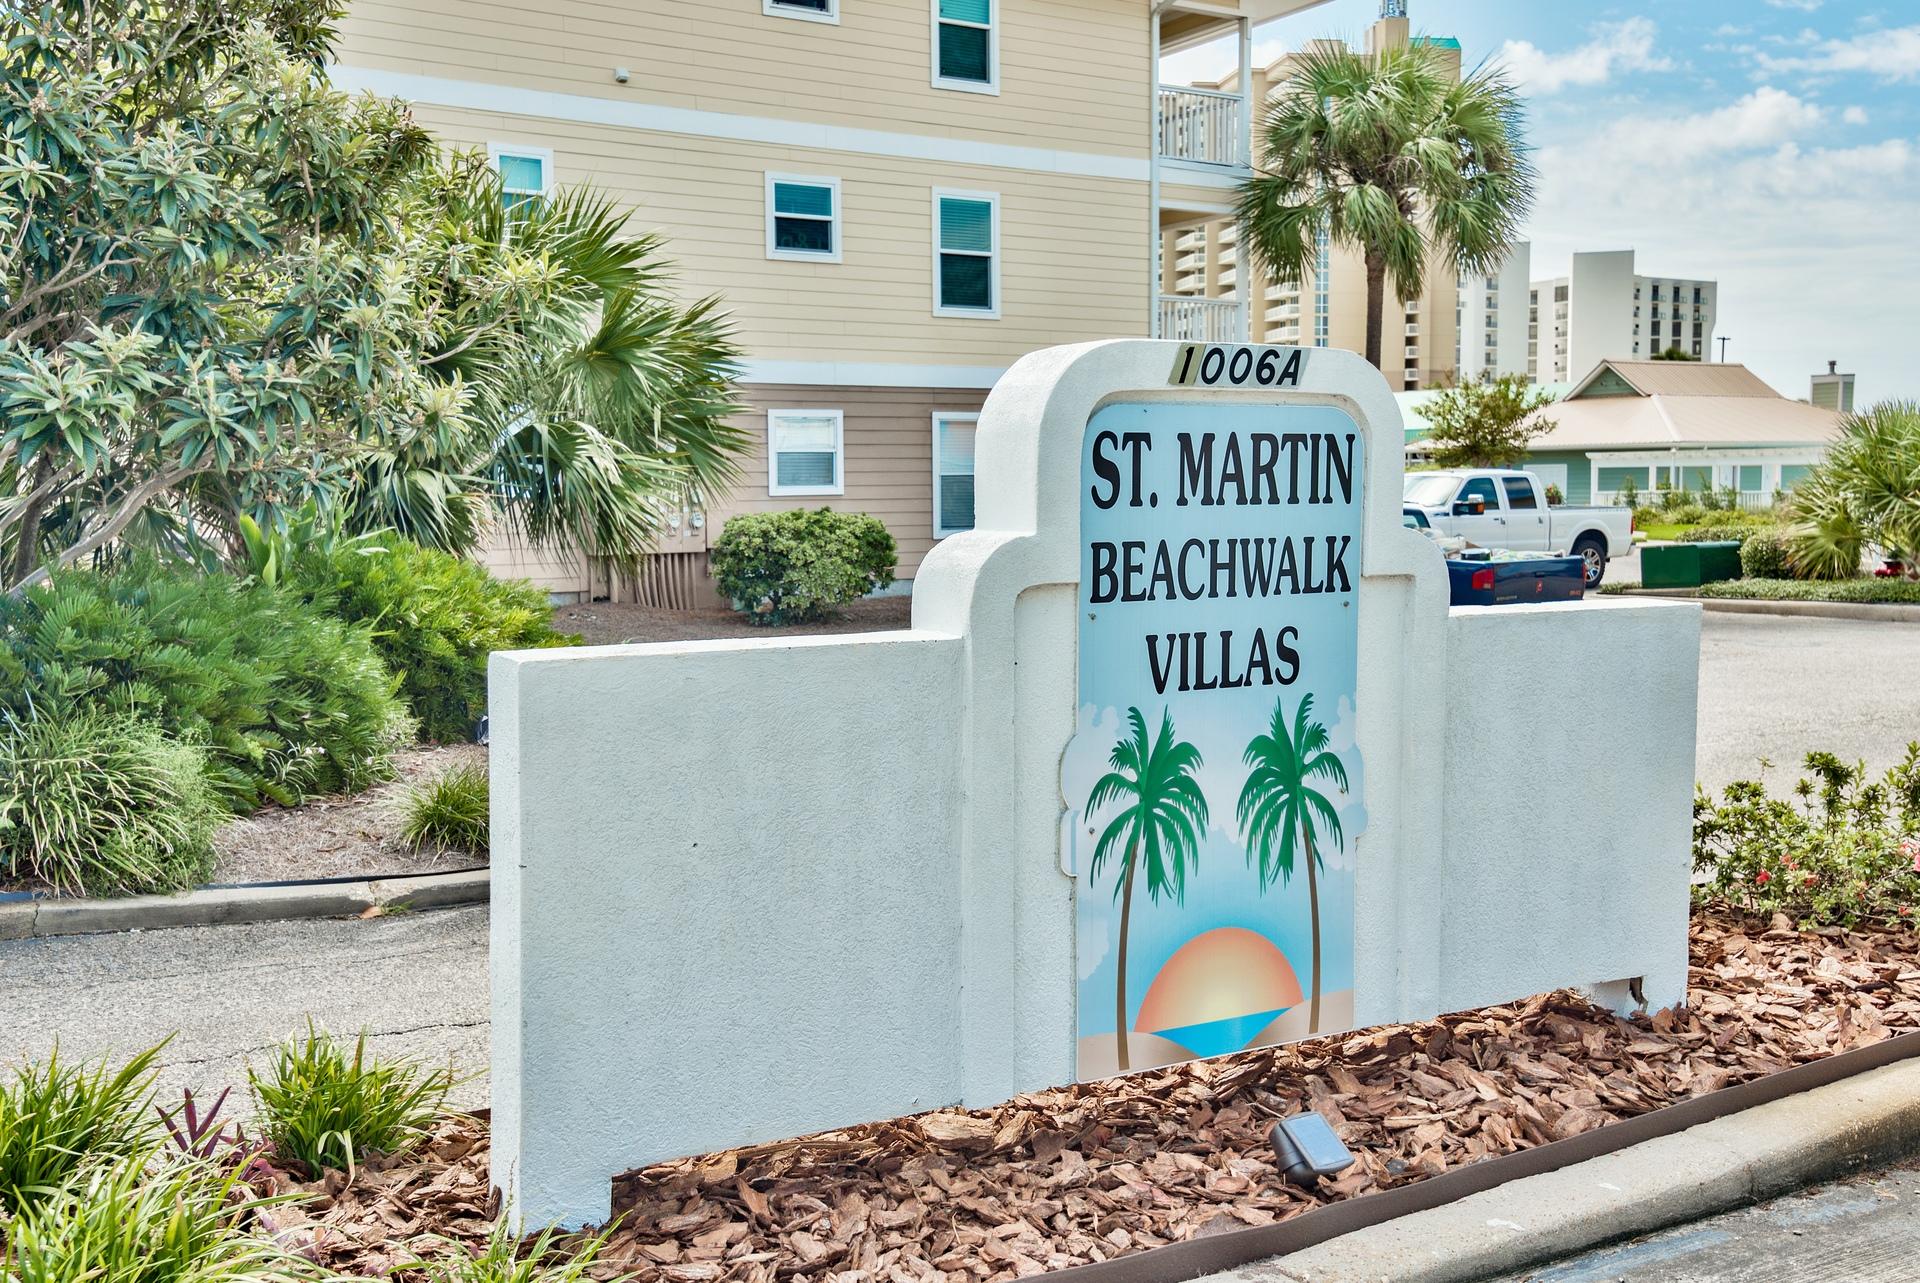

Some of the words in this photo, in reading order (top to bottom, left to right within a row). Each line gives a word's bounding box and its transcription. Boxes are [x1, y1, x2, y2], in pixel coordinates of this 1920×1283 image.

[1178, 346, 1302, 386] 1006A
[1090, 430, 1158, 510] ST.
[1176, 431, 1356, 507] MARTIN
[1089, 535, 1352, 604] BEACHWALK
[1145, 625, 1300, 695] VILLAS
